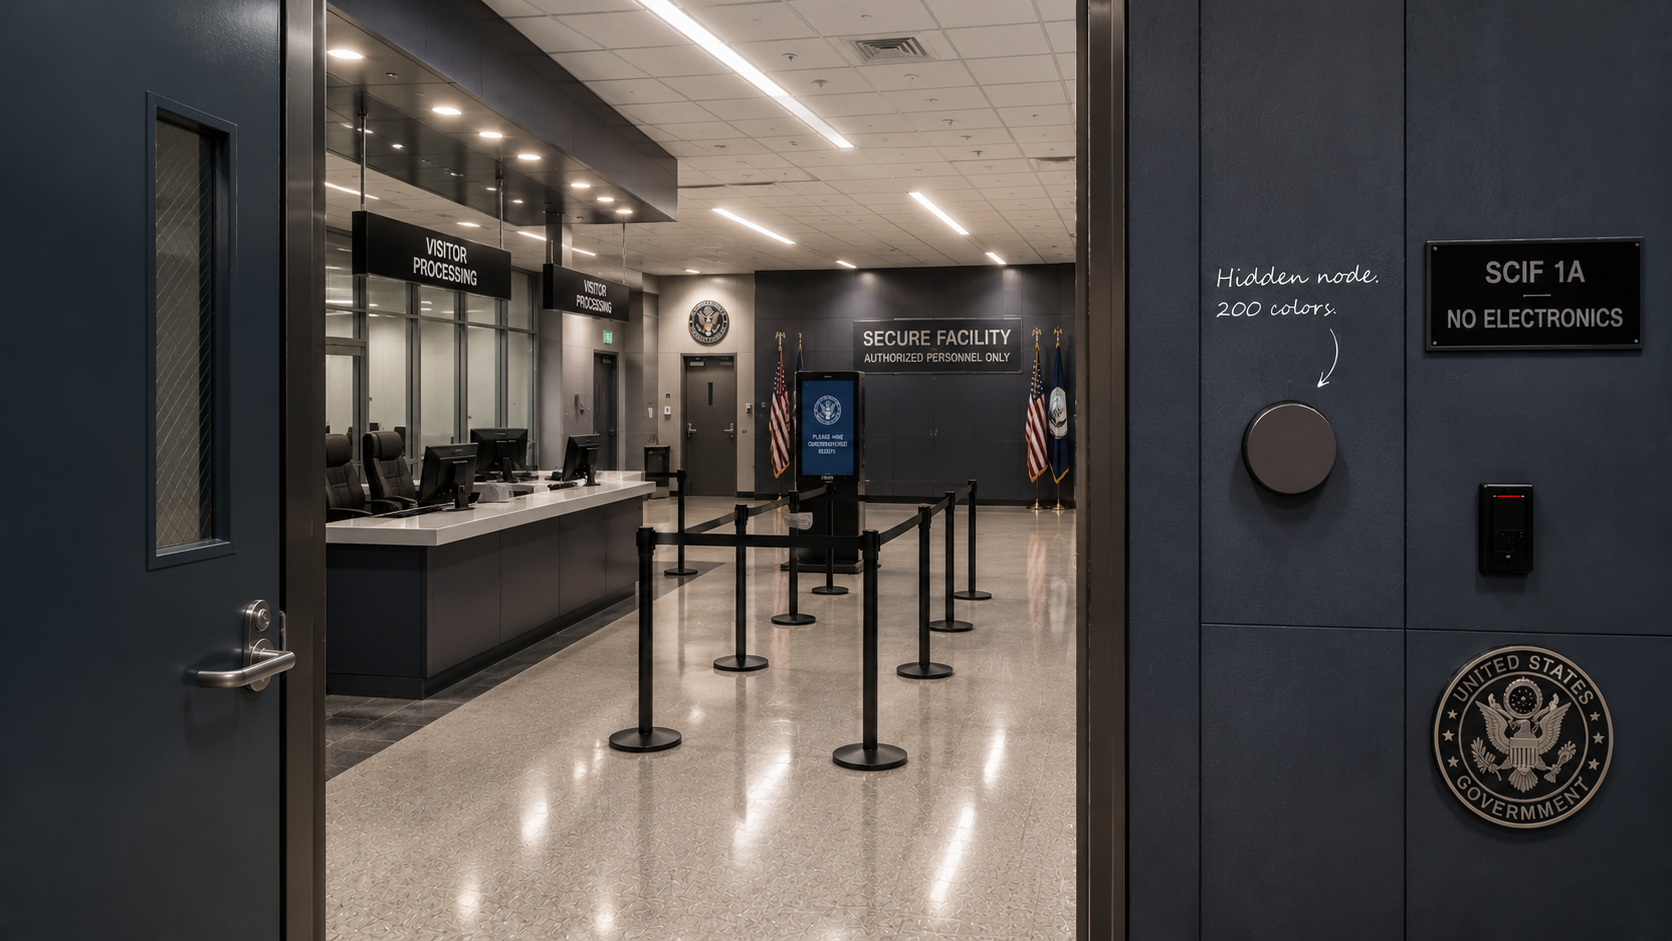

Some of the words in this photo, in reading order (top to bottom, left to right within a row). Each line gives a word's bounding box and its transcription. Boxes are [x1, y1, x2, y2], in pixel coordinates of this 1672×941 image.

[425, 236, 468, 264] VISITOR
[413, 256, 478, 286] PROCESSING
[1216, 265, 1310, 288] Hidden
[1317, 264, 1380, 285] node.
[1485, 260, 1544, 284] SCIF
[1554, 259, 1586, 283] 1A
[1216, 300, 1262, 318] 200
[1270, 298, 1337, 318] colors.
[1447, 308, 1476, 329] NO
[1484, 307, 1624, 329] ELECTRONICS
[863, 330, 931, 347] SECURE
[937, 328, 1012, 346] FACILITY
[863, 352, 924, 364] AUTHORIZED
[926, 352, 983, 363] PERSONNEL
[985, 352, 1011, 363] ONLY
[1453, 655, 1520, 702] UNITED
[1528, 655, 1594, 705] STATES
